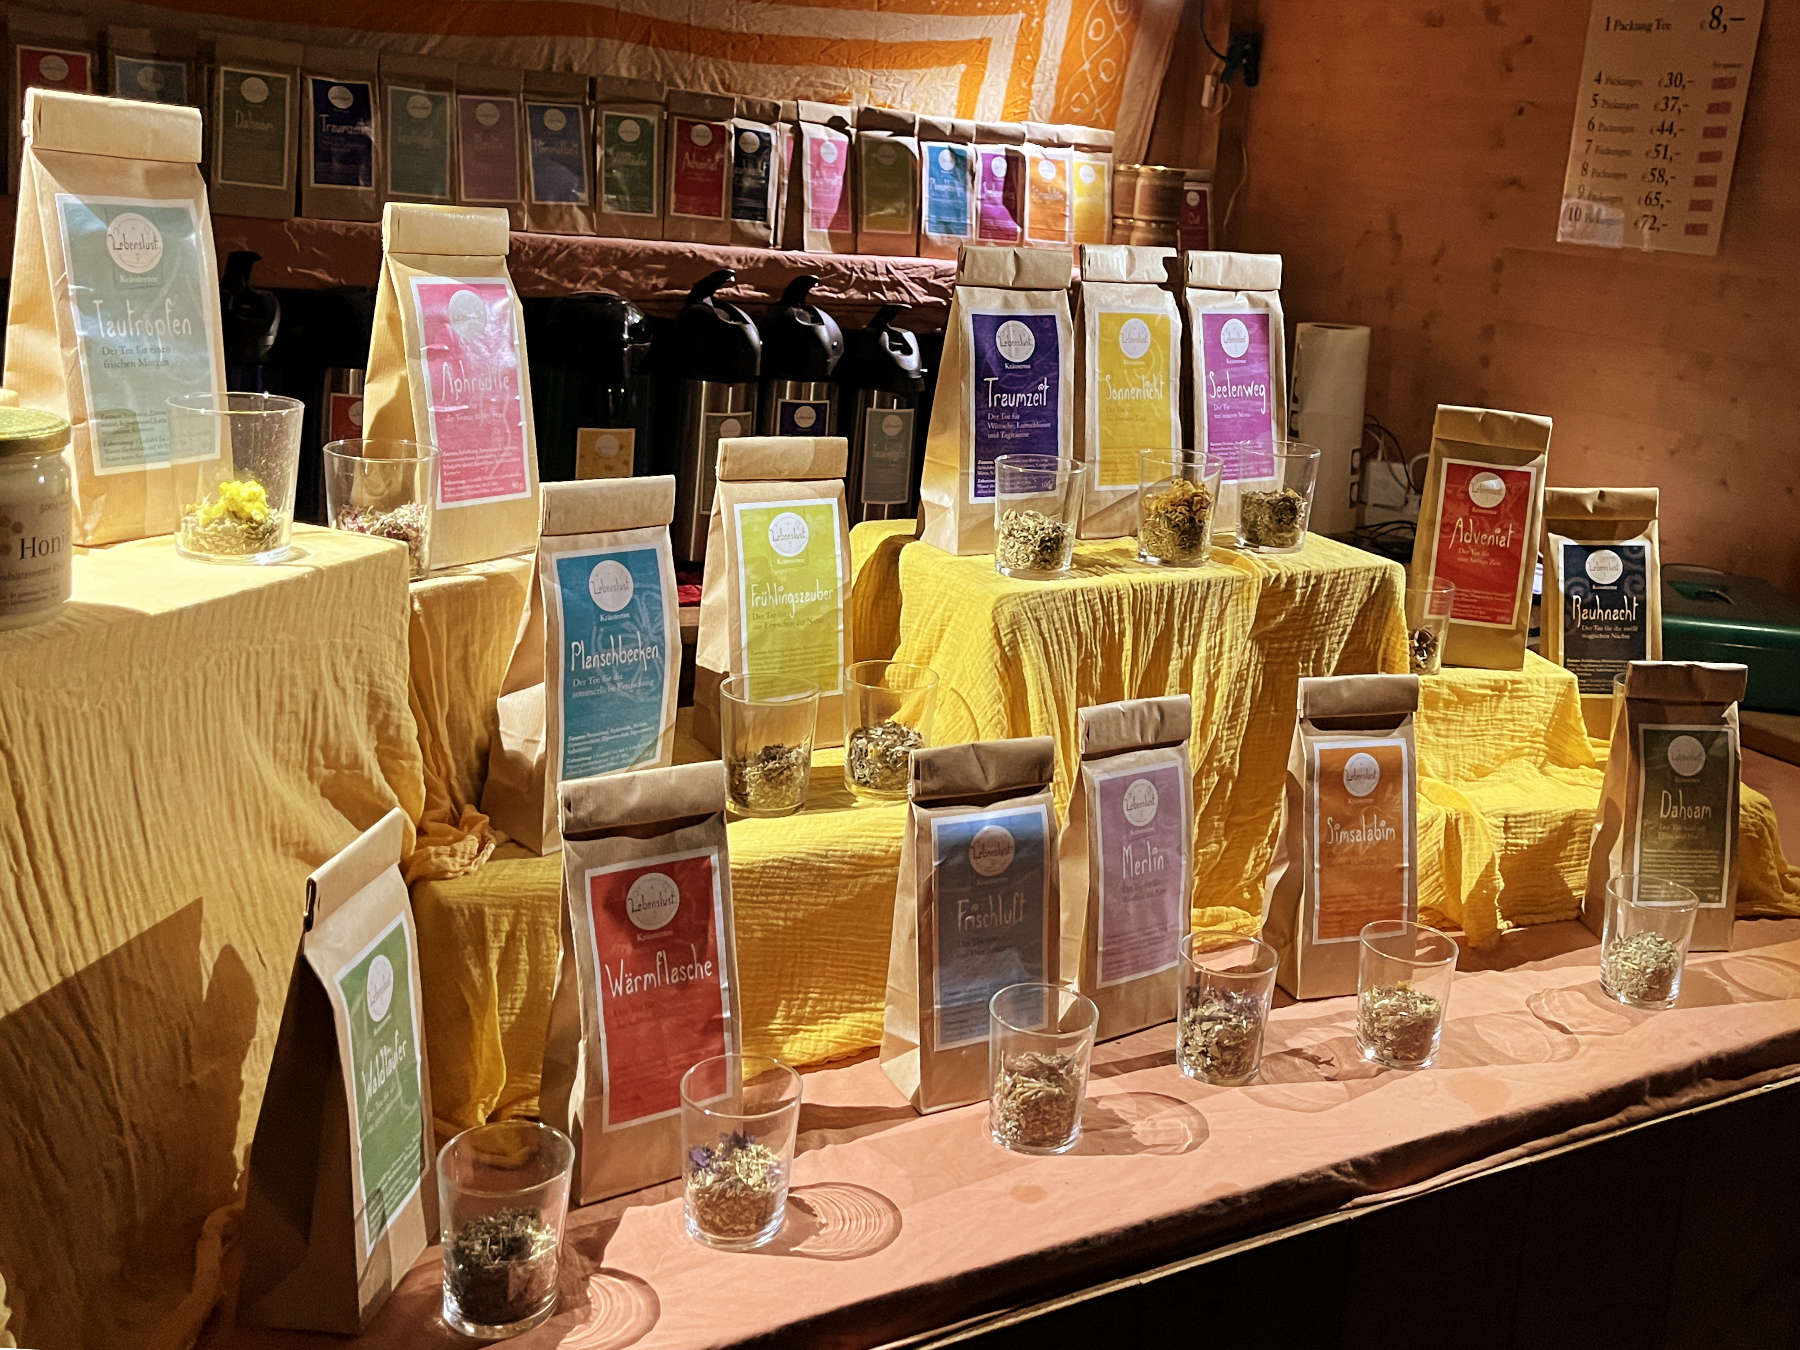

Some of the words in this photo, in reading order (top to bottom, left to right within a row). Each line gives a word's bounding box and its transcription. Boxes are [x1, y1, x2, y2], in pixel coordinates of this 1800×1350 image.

[1614, 20, 1652, 34] Packung
[1655, 18, 1672, 32] Tee
[1593, 70, 1602, 86] 4
[1590, 93, 1599, 110] 5
[1587, 116, 1596, 132] 6
[1584, 138, 1593, 155] 7
[1580, 161, 1589, 177] 8
[108, 230, 160, 251] Lebenslust
[92, 297, 193, 347] Tautropfen
[983, 376, 1050, 408] Traumzeit
[1208, 369, 1267, 415] Seelenweg
[1448, 517, 1515, 551] Adveniat
[750, 578, 834, 620] Frühlingszauber
[1572, 594, 1640, 628] Rauhnacht
[571, 630, 659, 672] Planschbecken
[1659, 789, 1712, 821] Dahoam
[1326, 814, 1397, 845] Simsalabim
[1122, 840, 1165, 880] Merlin
[628, 891, 676, 913] Lebenslust
[957, 891, 1025, 933] Frischluft
[604, 943, 713, 998] Wärmflasche
